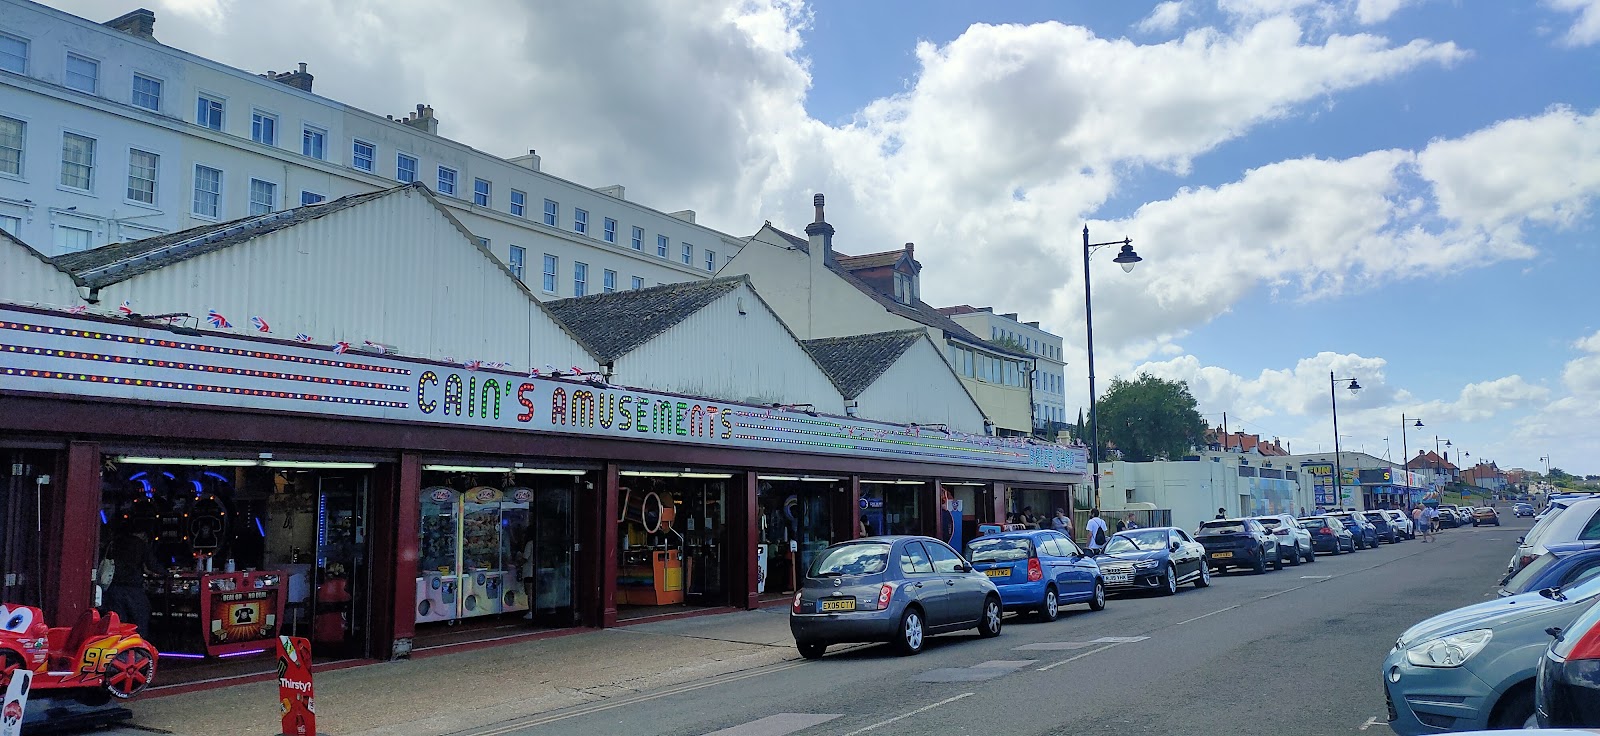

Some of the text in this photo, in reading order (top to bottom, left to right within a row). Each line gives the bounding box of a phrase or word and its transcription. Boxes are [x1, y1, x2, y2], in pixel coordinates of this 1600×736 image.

[417, 371, 733, 439] CAIN'S AMUSEMENTS
[280, 678, 312, 693] Thirsty?
